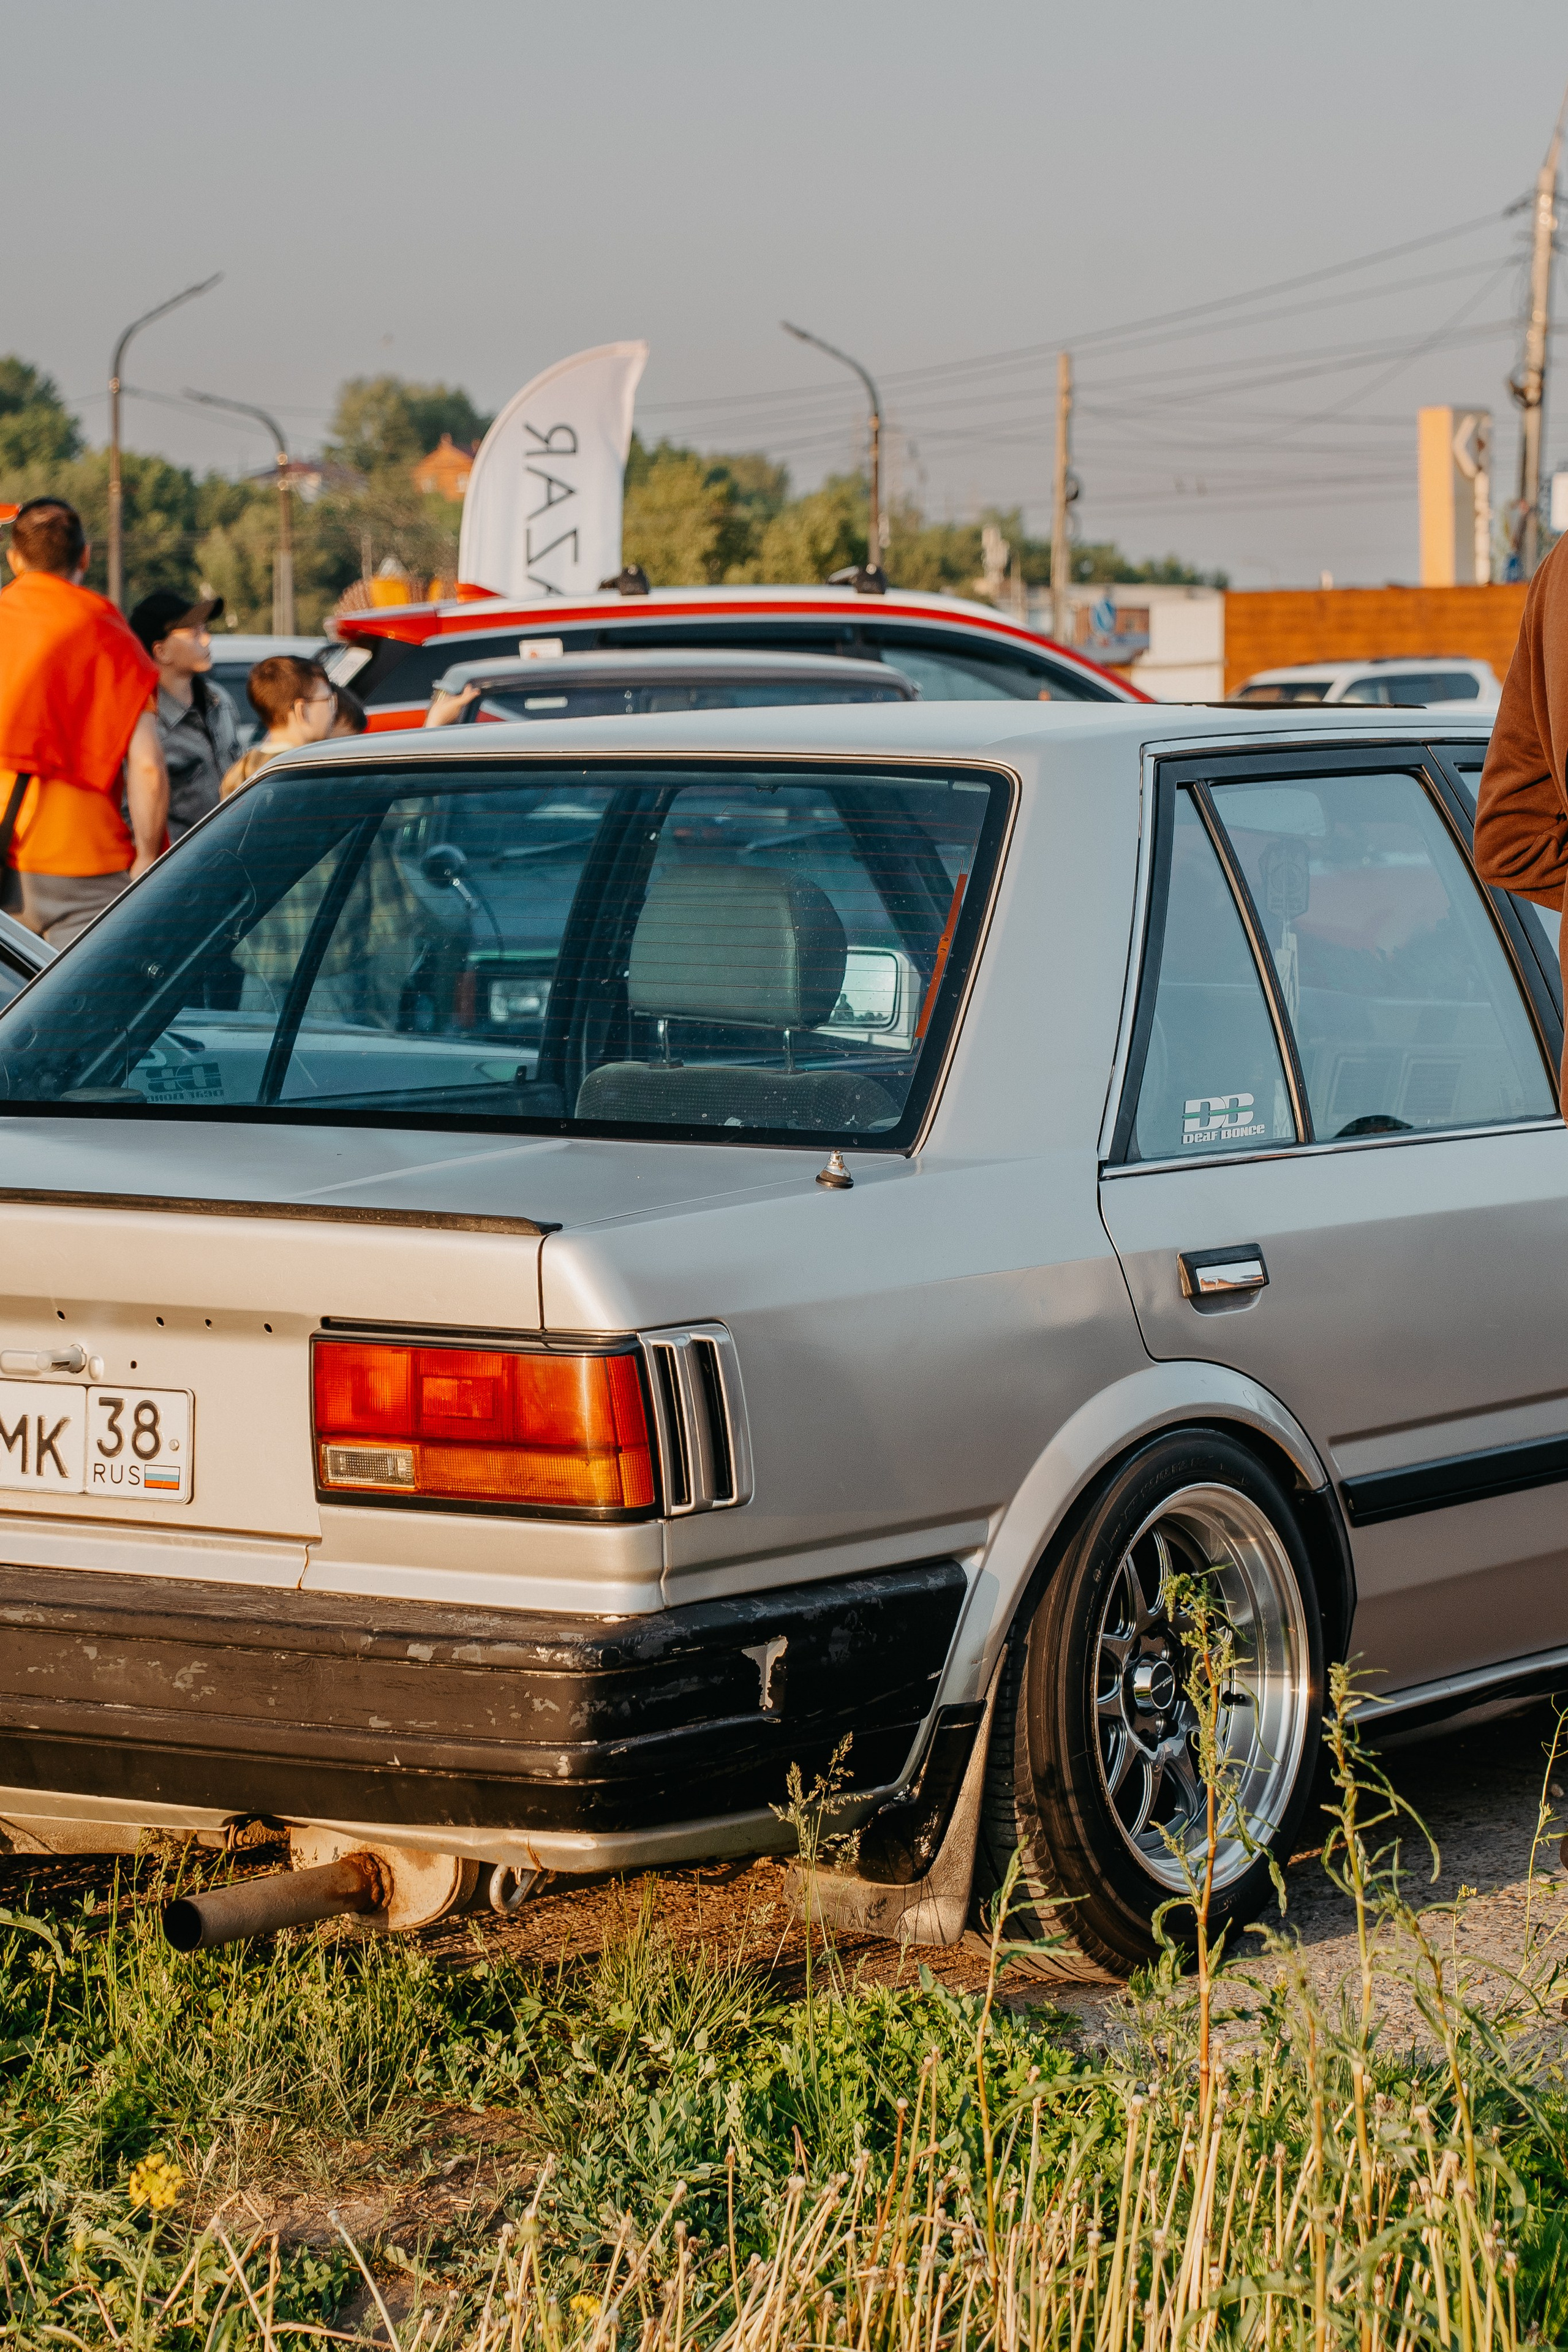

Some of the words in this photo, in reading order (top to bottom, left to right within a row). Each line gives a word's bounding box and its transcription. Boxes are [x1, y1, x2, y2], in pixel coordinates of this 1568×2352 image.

[1183, 1093, 1254, 1133] DB
[0, 1414, 72, 1478] MK
[96, 1396, 162, 1461] 38
[92, 1463, 140, 1485] RUS
